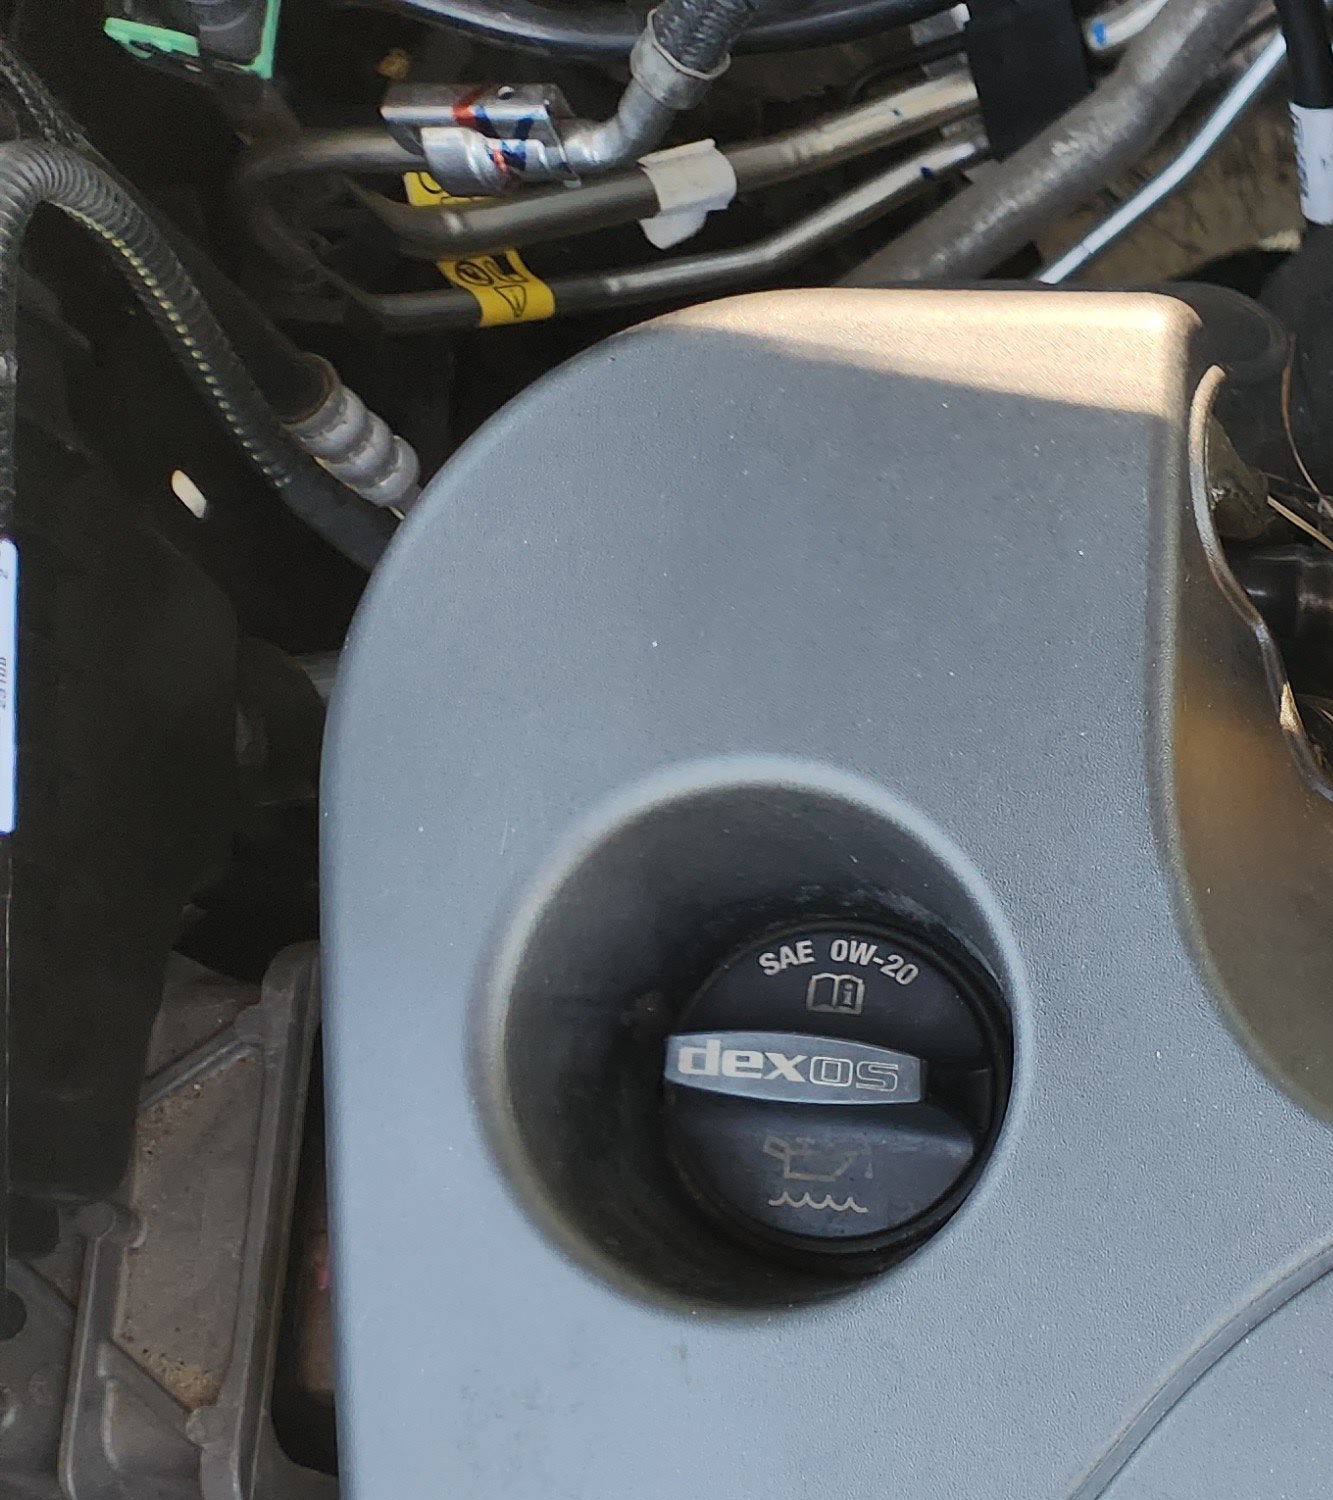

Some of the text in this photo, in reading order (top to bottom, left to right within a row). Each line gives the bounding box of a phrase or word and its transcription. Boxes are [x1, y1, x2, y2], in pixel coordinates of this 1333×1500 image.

[758, 938, 920, 987] SAE 0W-20
[676, 1039, 900, 1093] dexos
